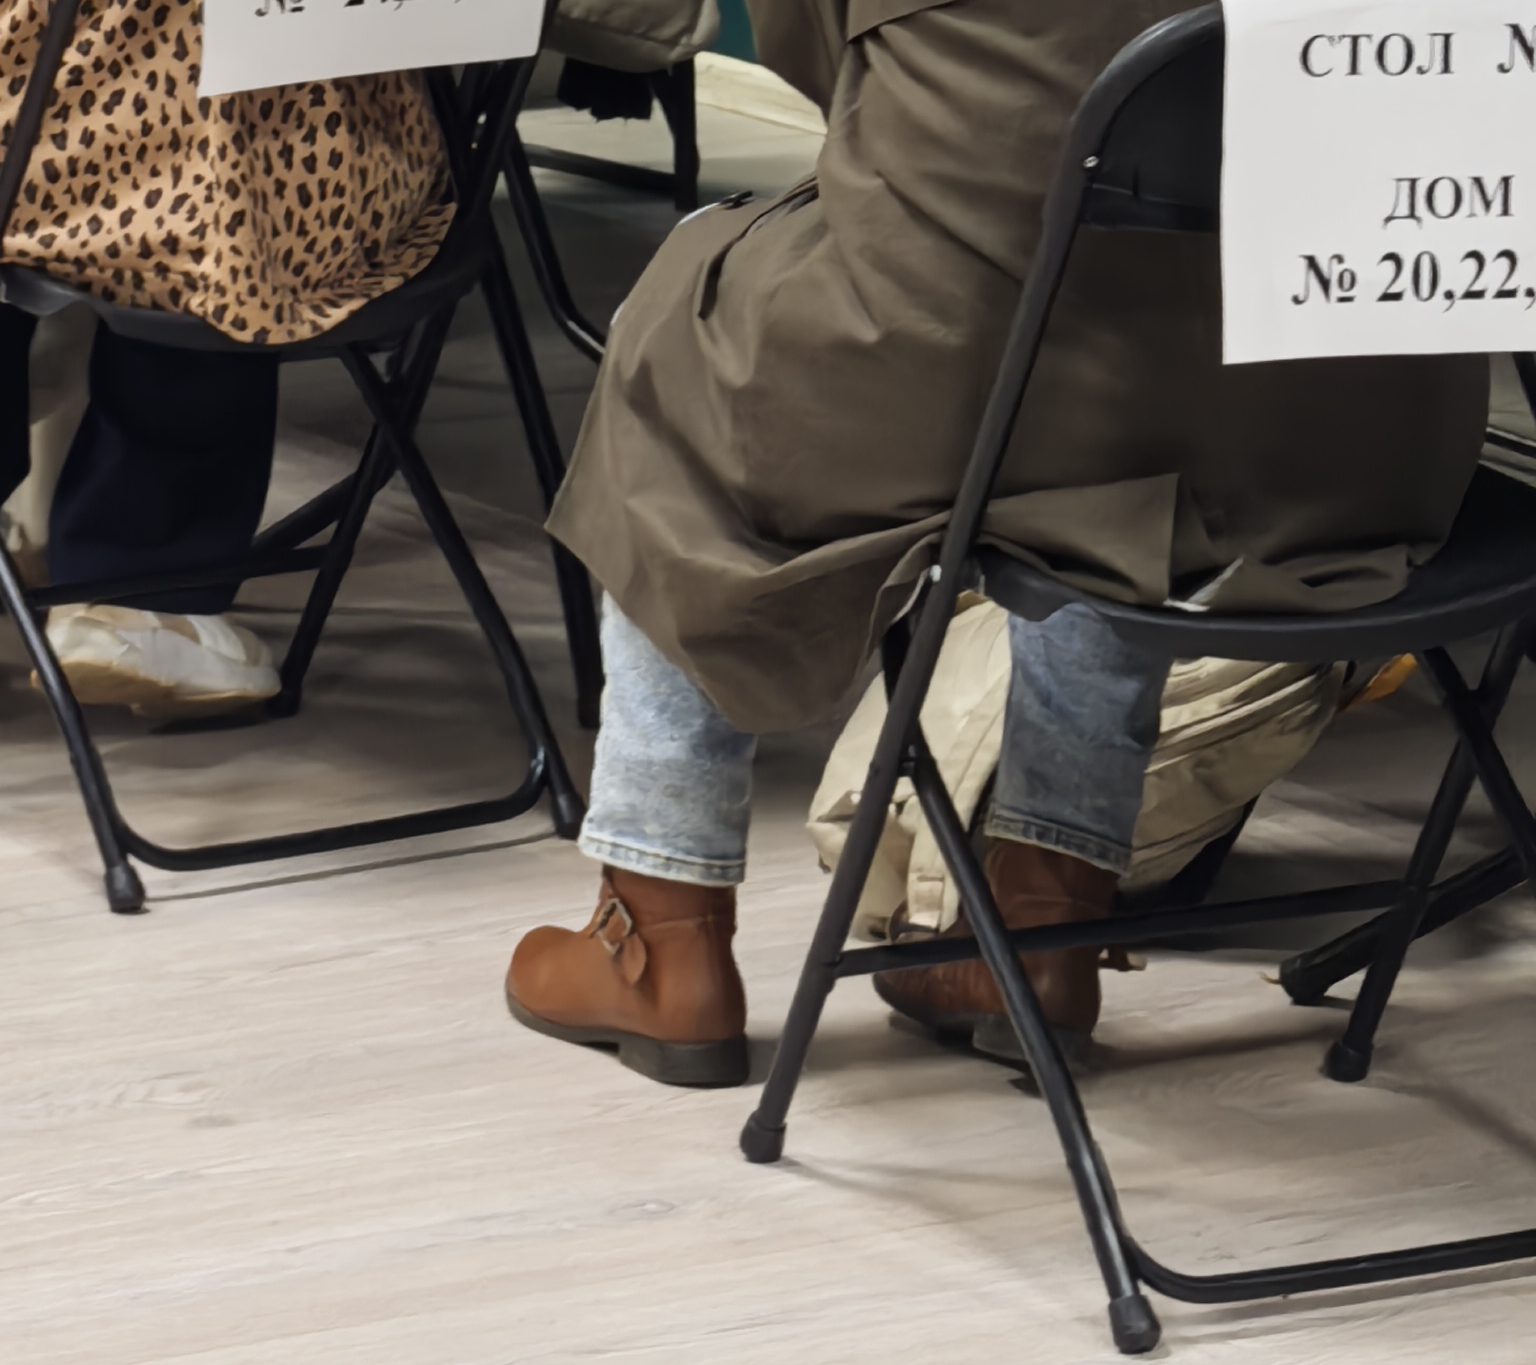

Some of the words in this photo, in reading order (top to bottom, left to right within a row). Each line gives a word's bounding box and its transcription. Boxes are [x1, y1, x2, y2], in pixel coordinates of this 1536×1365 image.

[1298, 32, 1456, 78] СТОЛ
[1381, 174, 1517, 230] ДОМ
[1290, 252, 1358, 306] №
